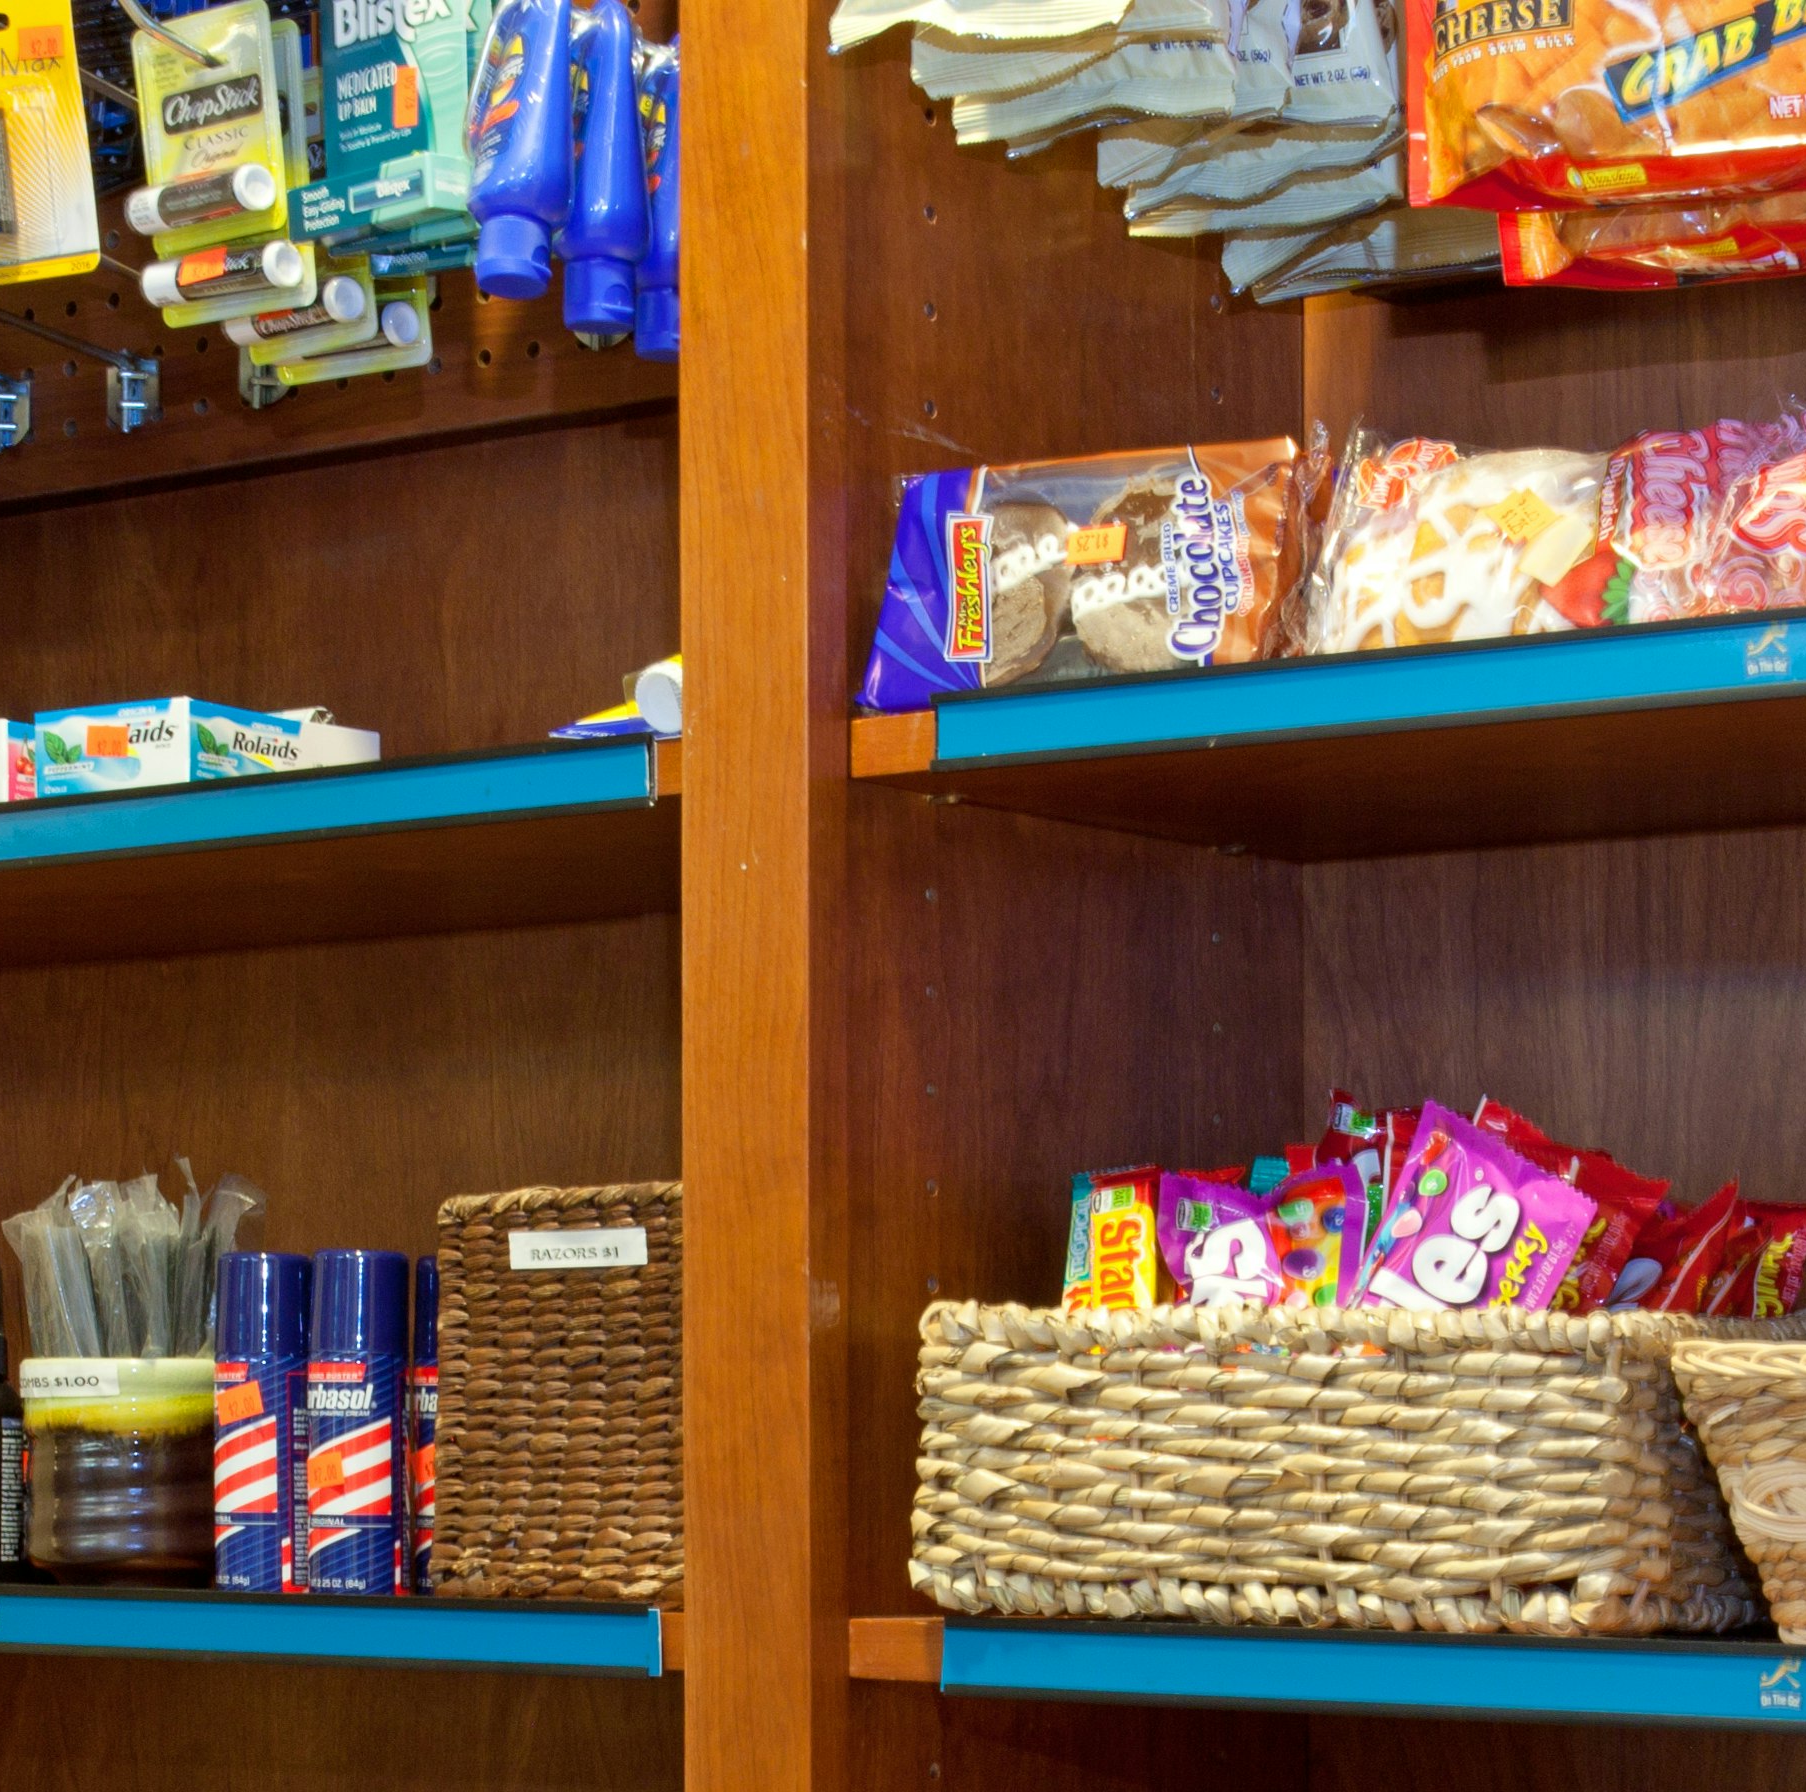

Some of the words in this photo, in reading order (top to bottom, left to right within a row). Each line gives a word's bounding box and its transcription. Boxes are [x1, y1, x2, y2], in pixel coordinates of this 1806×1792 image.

[1622, 19, 1756, 106] GRAB
[336, 60, 398, 99] MEDICATED
[163, 76, 260, 127] ChapStick
[337, 102, 357, 123] LIP
[355, 95, 378, 120] BALM
[183, 126, 249, 151] CLASSIC
[301, 186, 330, 202] Smooth
[375, 178, 411, 200] Blistex
[302, 198, 346, 220] Easy-Gliding
[304, 214, 341, 233] Protection
[1598, 456, 1628, 542] Danish
[1162, 522, 1177, 563] FILLED
[1213, 502, 1240, 613] CUPCAKES
[1170, 477, 1224, 656] Chocolate
[957, 523, 991, 656] Freshley's
[1163, 564, 1180, 613] CREME
[231, 730, 302, 762] Rolaids
[530, 1244, 598, 1263] RAZORS
[53, 1375, 100, 1388] $1.00
[228, 1396, 256, 1413] $2.00
[312, 1463, 338, 1477] $2.00
